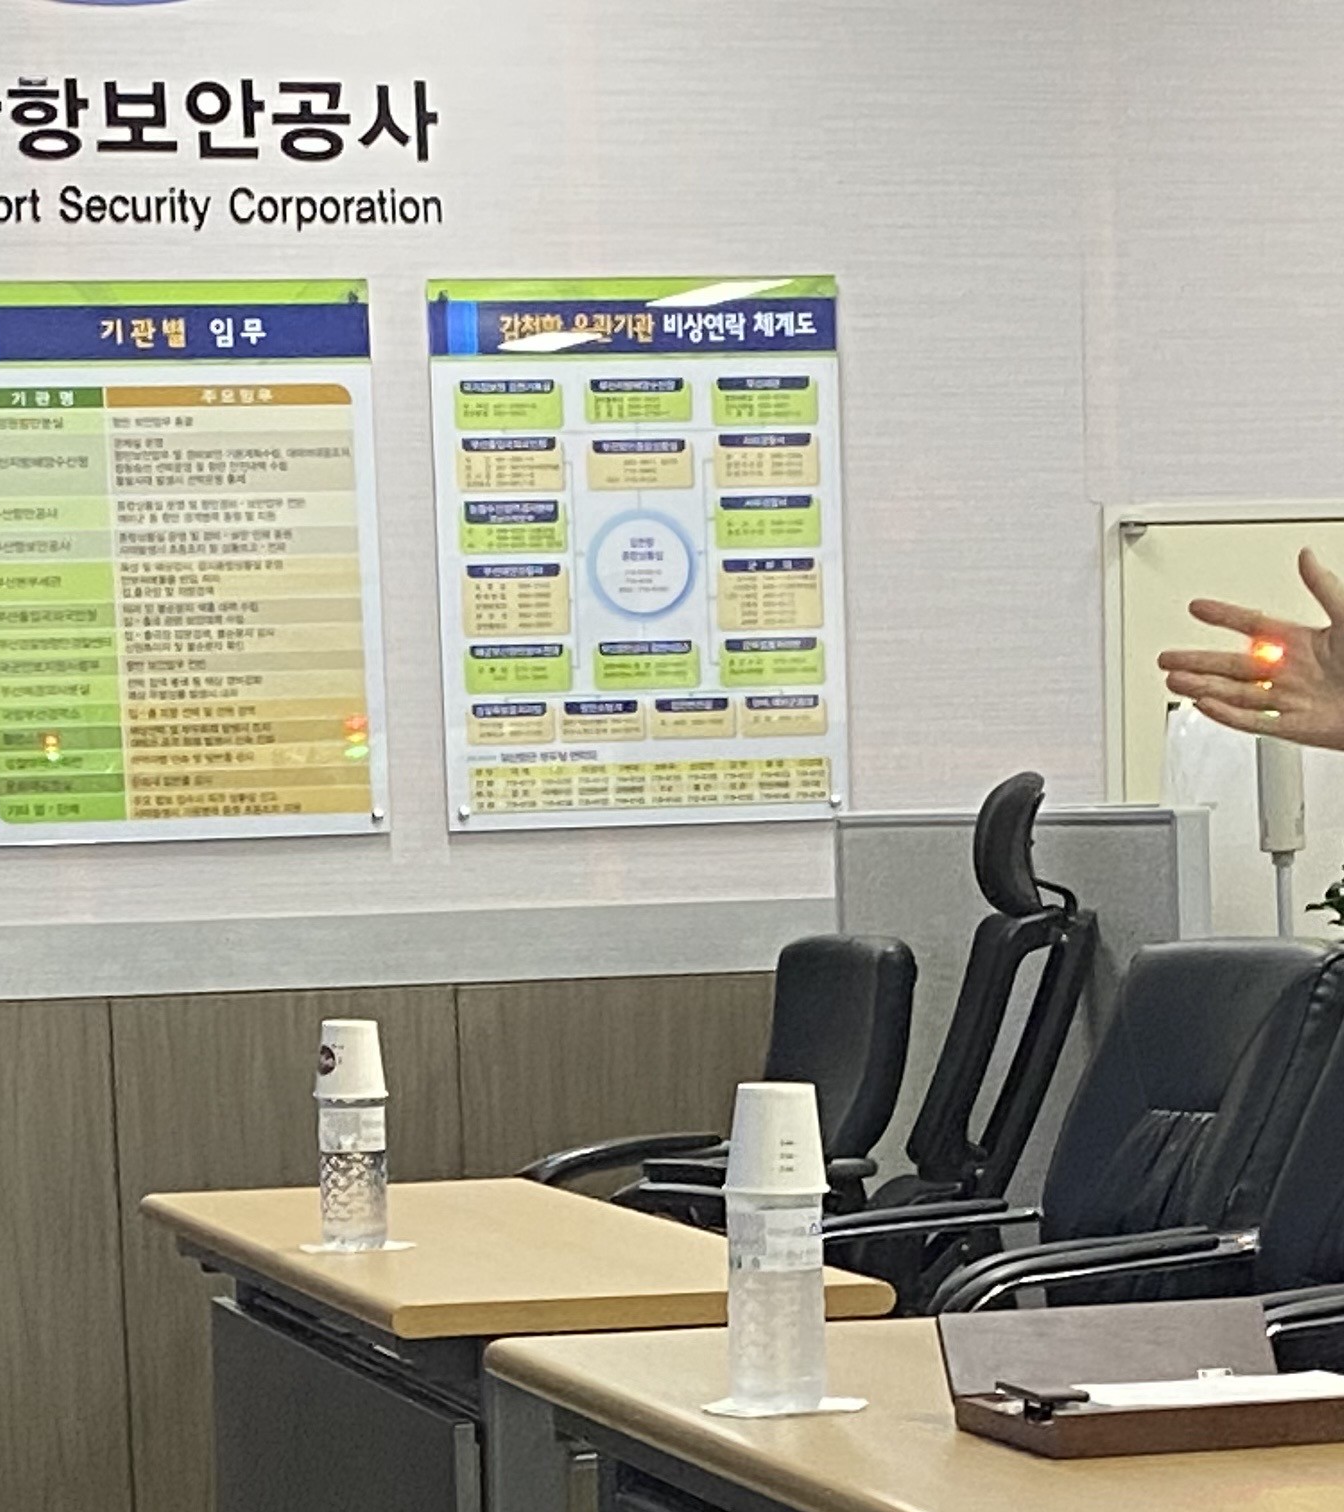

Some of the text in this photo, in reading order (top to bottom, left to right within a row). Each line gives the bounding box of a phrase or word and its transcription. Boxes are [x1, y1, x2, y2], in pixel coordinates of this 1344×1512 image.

[59, 187, 210, 231] Security
[228, 188, 443, 231] Corporation
[99, 317, 267, 349] 기관별 임무
[663, 313, 745, 343] 비상연락
[753, 311, 818, 337] 체계도
